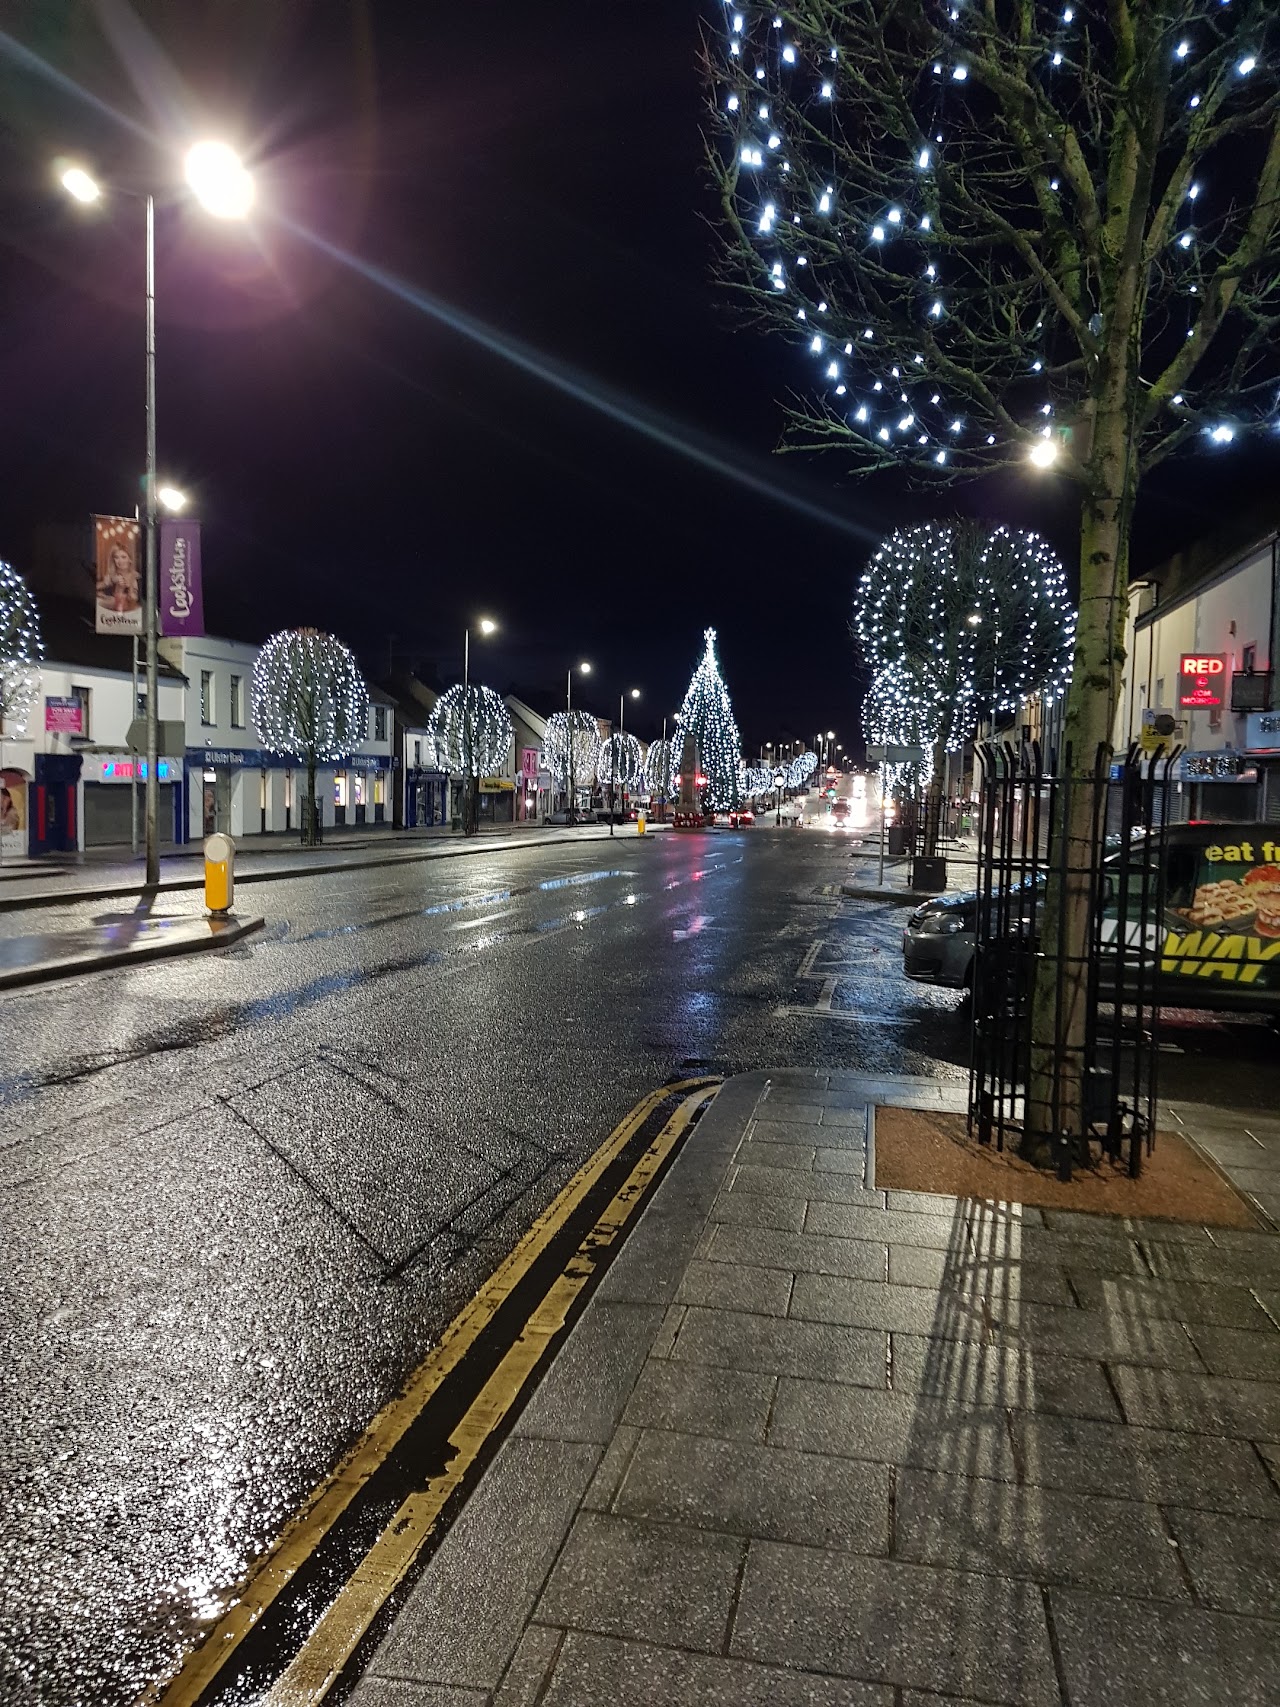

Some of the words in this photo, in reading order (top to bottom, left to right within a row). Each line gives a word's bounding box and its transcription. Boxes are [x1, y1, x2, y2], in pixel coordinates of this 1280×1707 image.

[168, 537, 194, 618] Cookstown
[1183, 659, 1224, 674] RED
[1205, 842, 1254, 862] eat
